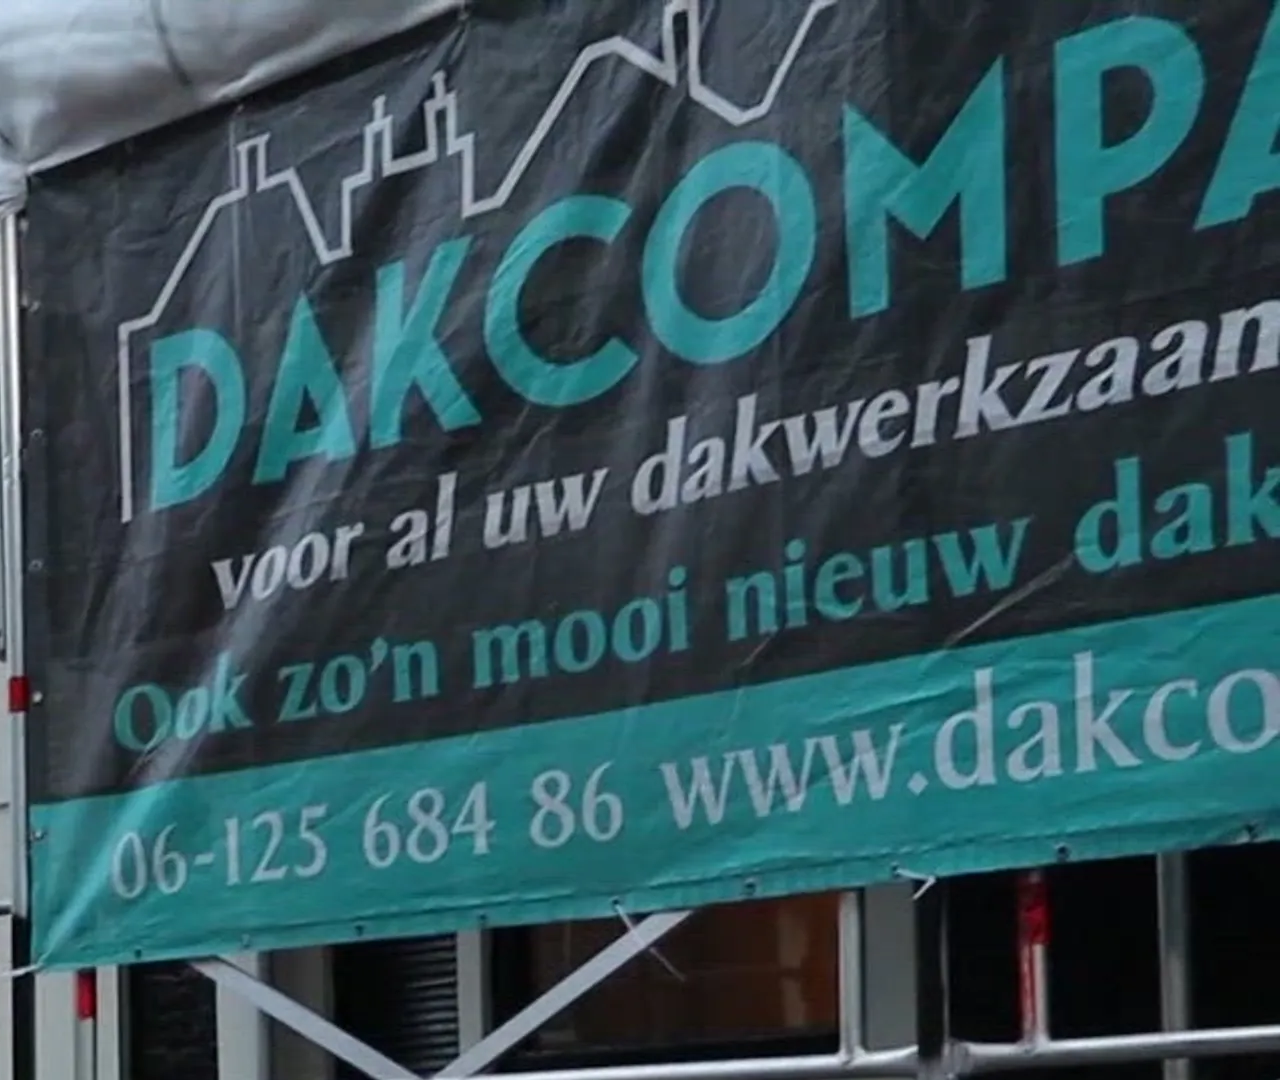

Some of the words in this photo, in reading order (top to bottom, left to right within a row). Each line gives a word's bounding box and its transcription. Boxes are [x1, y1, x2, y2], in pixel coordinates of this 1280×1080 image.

[114, 651, 252, 754] Ook
[277, 637, 438, 722] zo'n
[473, 566, 688, 690] mooi
[725, 516, 1036, 642] nieuw
[1074, 429, 1280, 573] dak
[211, 520, 364, 610] voor
[386, 472, 457, 570] al
[483, 468, 609, 549] uw
[110, 805, 329, 899] 06-125
[363, 780, 497, 869] 684
[529, 761, 623, 848] 86
[659, 650, 1280, 830] www.dakco
